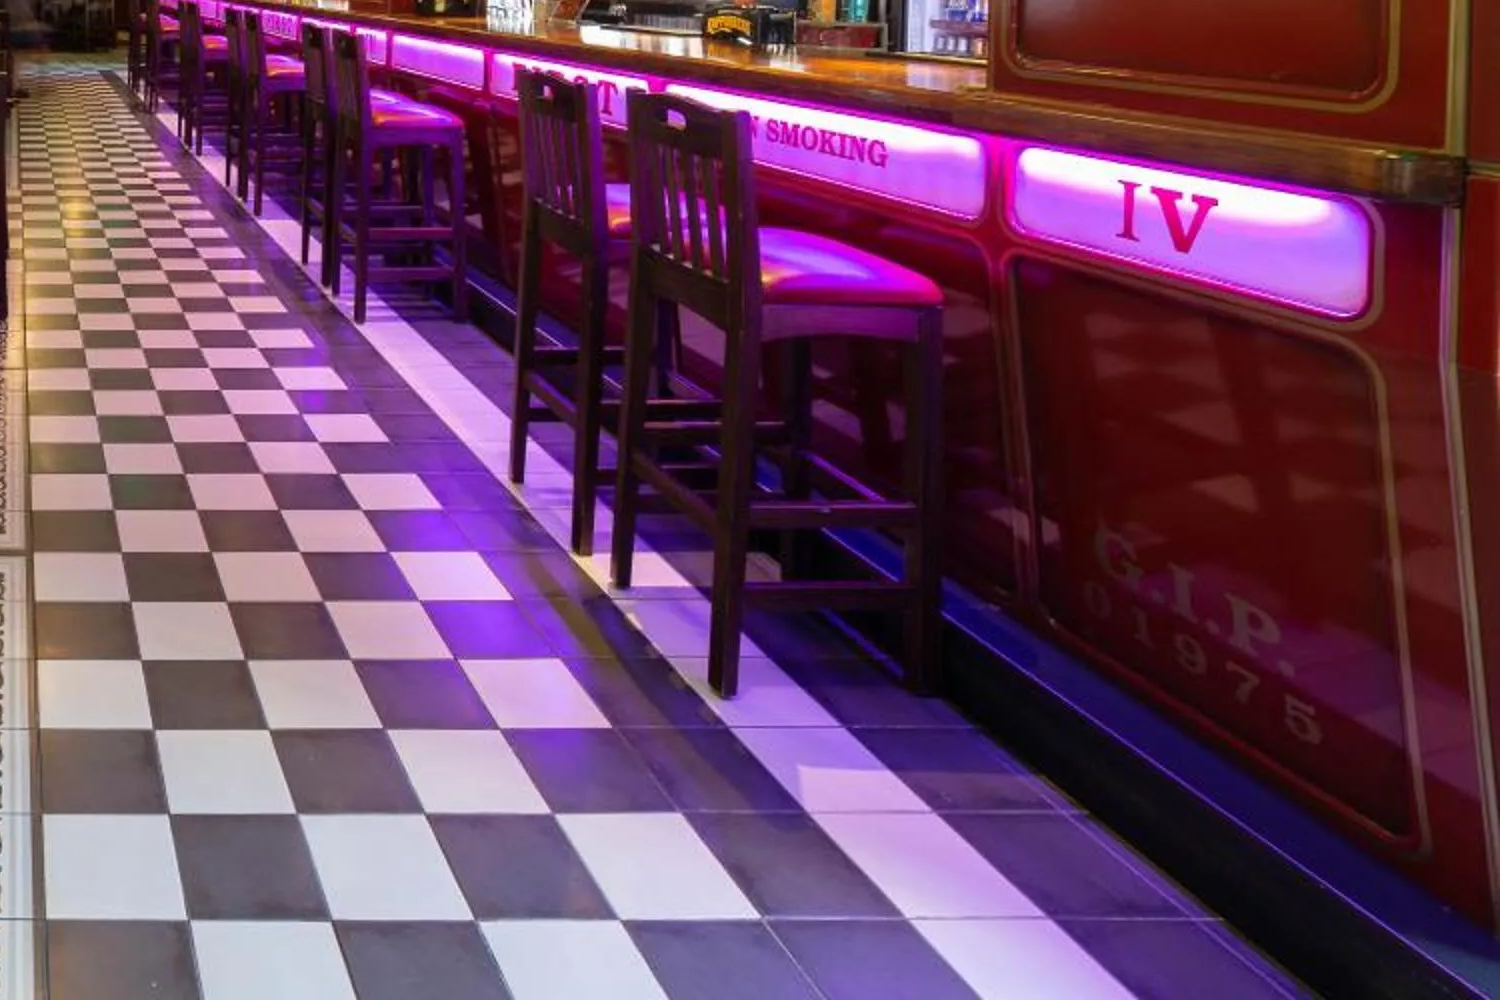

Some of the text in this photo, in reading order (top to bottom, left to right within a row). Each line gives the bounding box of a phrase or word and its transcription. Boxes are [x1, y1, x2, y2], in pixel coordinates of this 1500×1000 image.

[766, 118, 888, 168] SMOKING
[1115, 179, 1218, 254] IV
[1083, 578, 1323, 745] 01975
